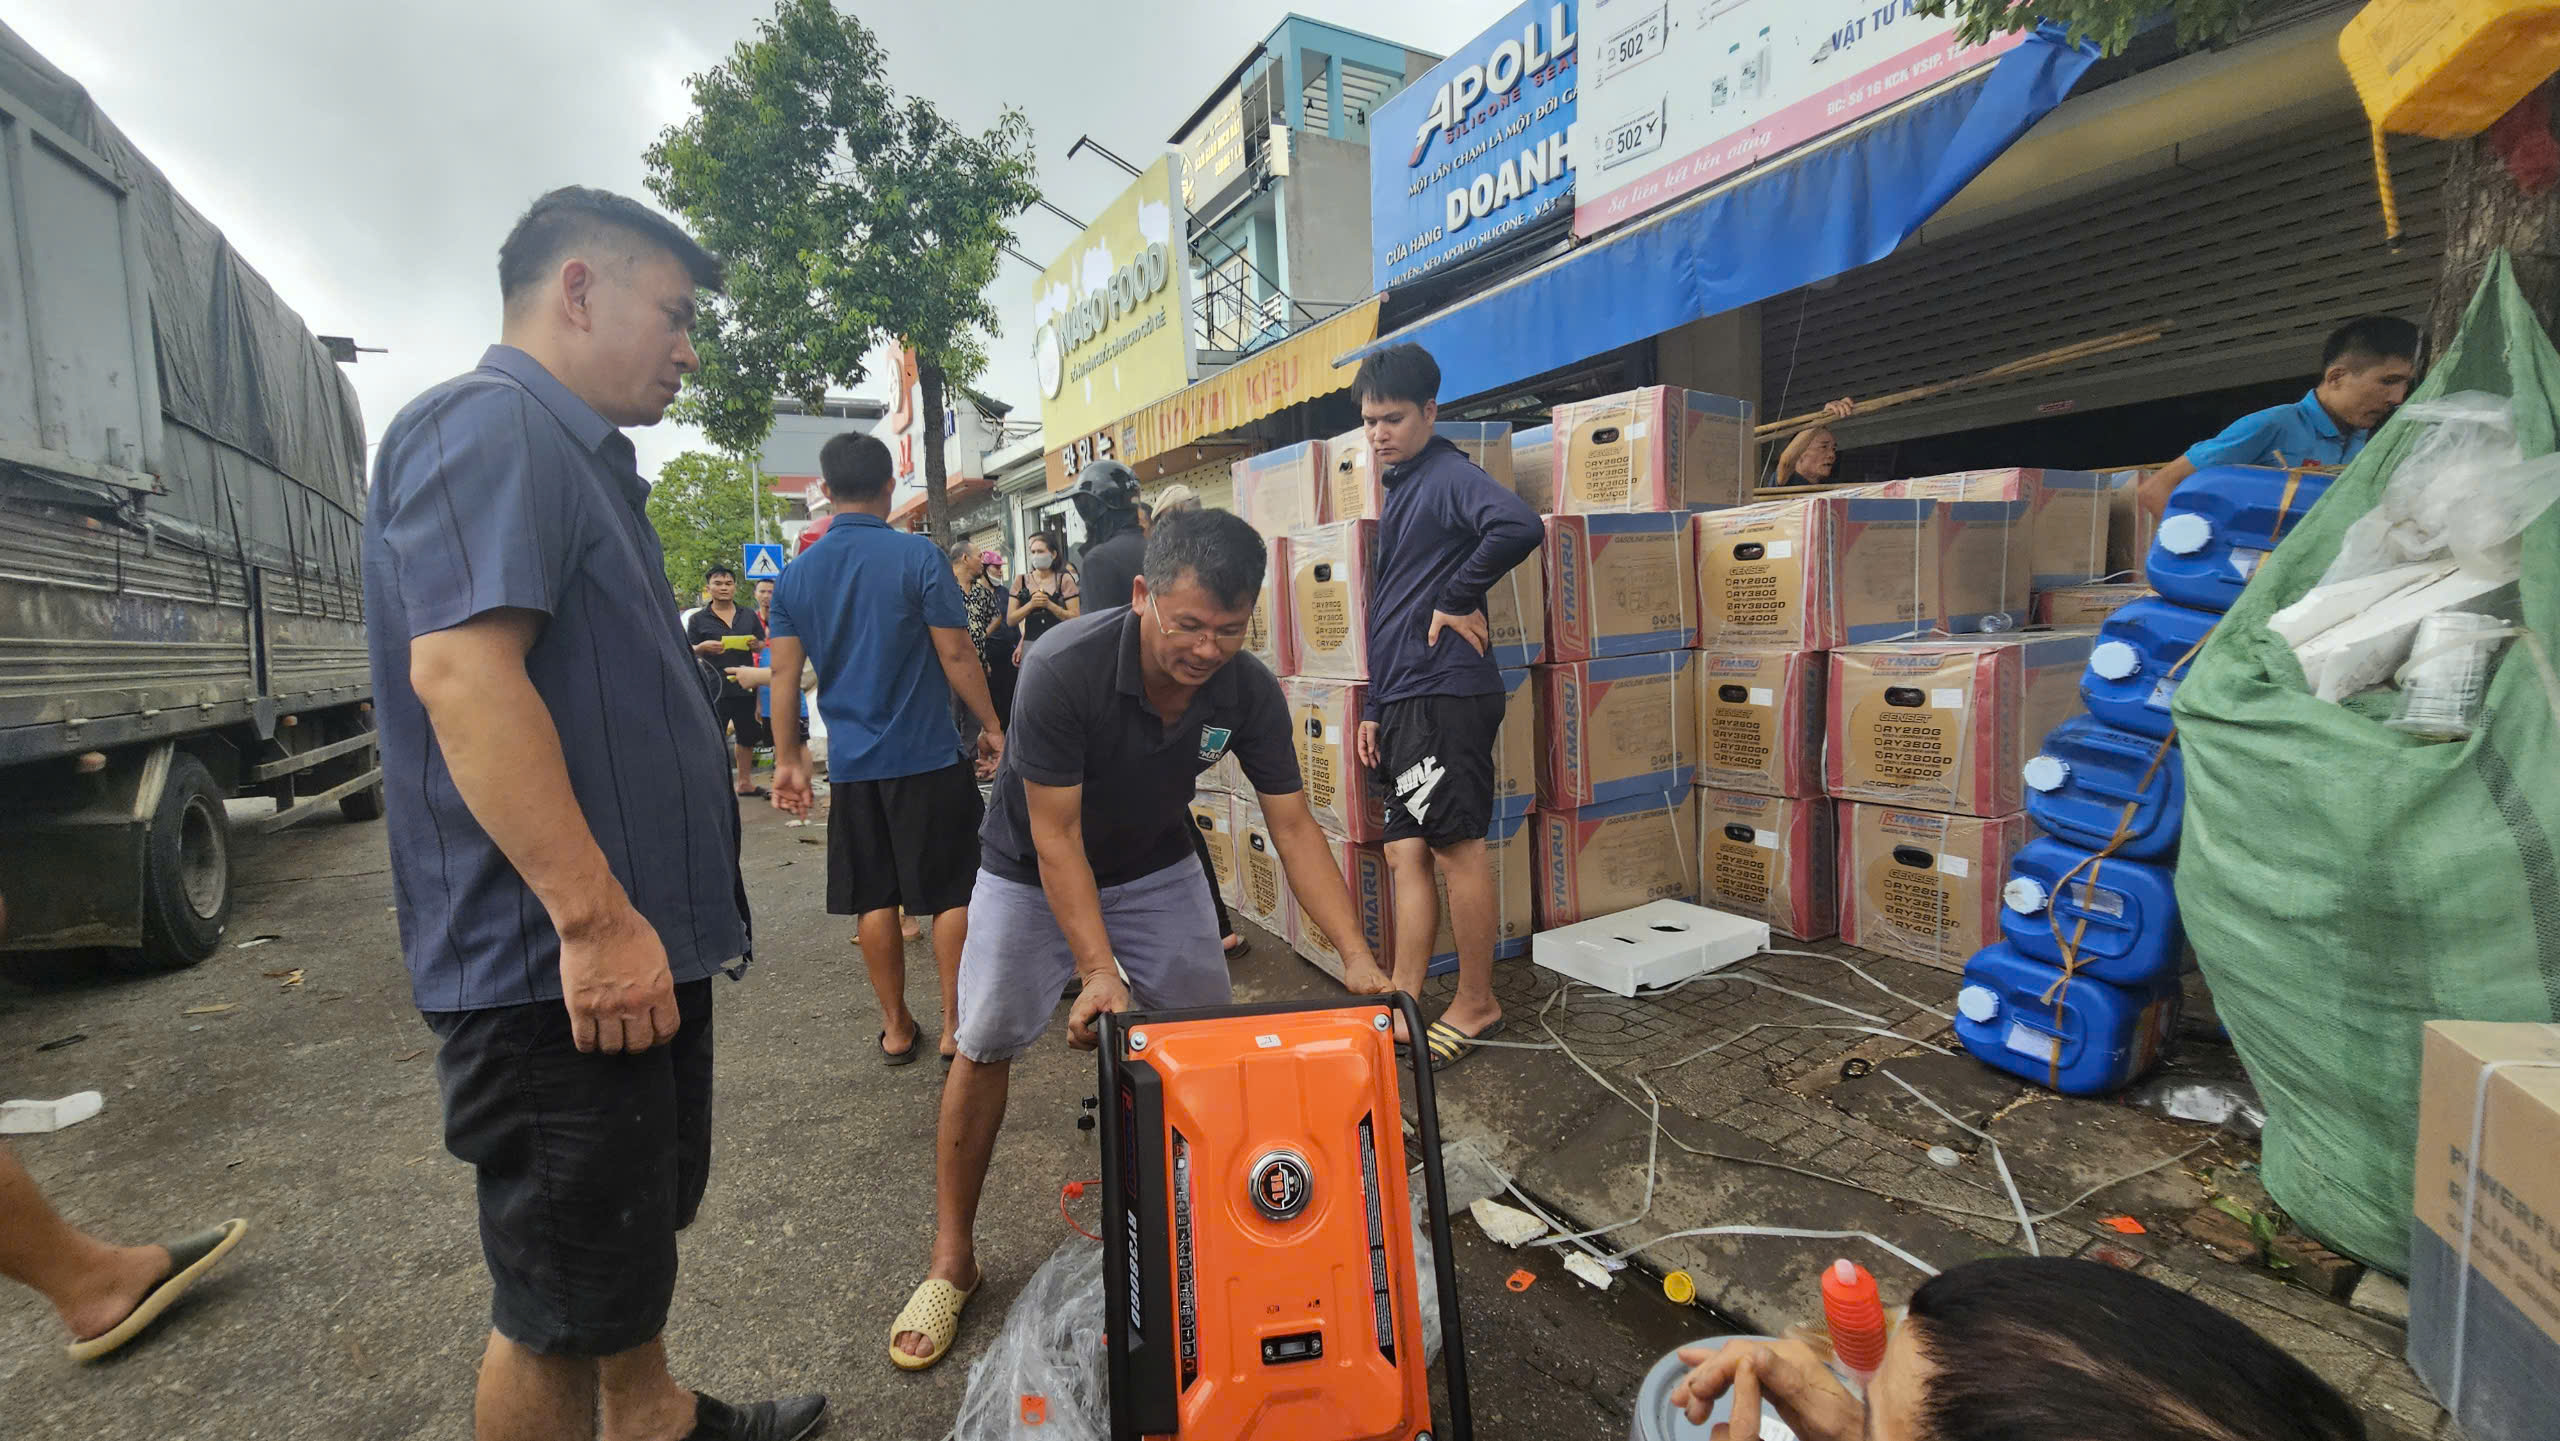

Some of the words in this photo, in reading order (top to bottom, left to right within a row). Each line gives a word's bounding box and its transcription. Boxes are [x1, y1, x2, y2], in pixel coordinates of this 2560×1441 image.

[1831, 17, 1866, 51] VẬT
[1620, 33, 1643, 62] 502
[1445, 89, 1521, 144] SILICONE
[1453, 144, 1488, 169] CHẠM
[1489, 125, 1504, 148] LÀ
[1506, 111, 1533, 139] MỘT
[1618, 125, 1641, 154] 502
[1446, 121, 1576, 233] DOANH
[1410, 225, 1443, 255] HÀNG
[1442, 237, 1477, 263] APOLLO
[1478, 214, 1525, 244] SILICONE
[1058, 287, 1109, 357] NABO
[1107, 241, 1169, 322] FOOD
[1730, 565, 1770, 576] GENSET
[1732, 577, 1777, 586] RY280G
[1733, 589, 1777, 598] RY380G
[1734, 601, 1786, 610] RY380GD
[1734, 614, 1778, 622] RY400G
[1873, 655, 1942, 668] RYMARU
[1719, 719, 1760, 730] RY280G
[1880, 712, 1932, 724] GENSET
[1720, 730, 1760, 742] RY380G
[1883, 725, 1942, 736] RY280G
[1720, 743, 1769, 755] RY380GD
[1883, 738, 1942, 750] RY380G
[1720, 754, 1762, 766] RY400G
[1884, 752, 1953, 765] RY380GD
[1884, 765, 1942, 778] RY400G
[1722, 855, 1765, 870] RY280G
[1722, 867, 1765, 881] RY380G
[1889, 869, 1939, 886] GENSET
[1362, 860, 1380, 950] YMARU
[1270, 1171, 1285, 1201] 15L
[1127, 1208, 1141, 1329] RY380GD
